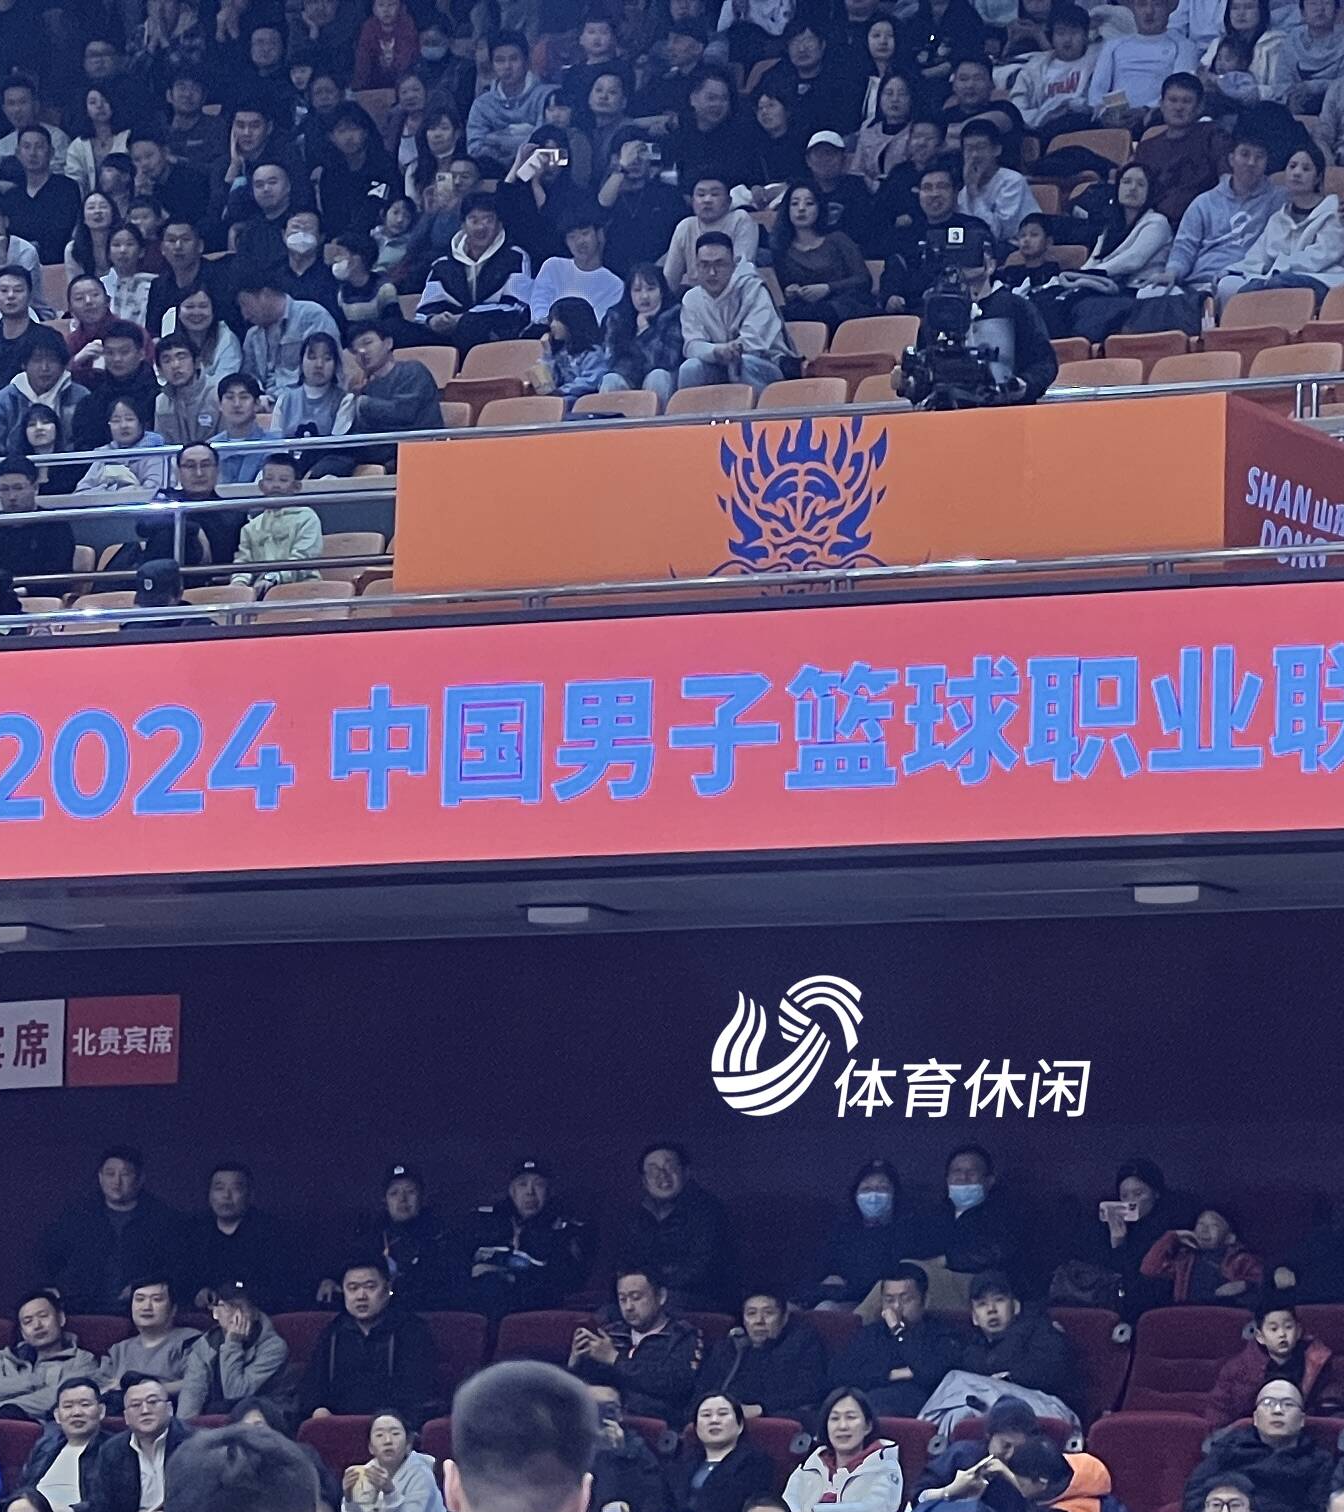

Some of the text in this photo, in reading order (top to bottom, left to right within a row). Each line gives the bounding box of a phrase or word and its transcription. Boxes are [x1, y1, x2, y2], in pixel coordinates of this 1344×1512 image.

[1245, 466, 1312, 524] SHAN
[72, 1025, 173, 1057] 北贵宾席
[833, 1056, 1092, 1119] 体育休闲
